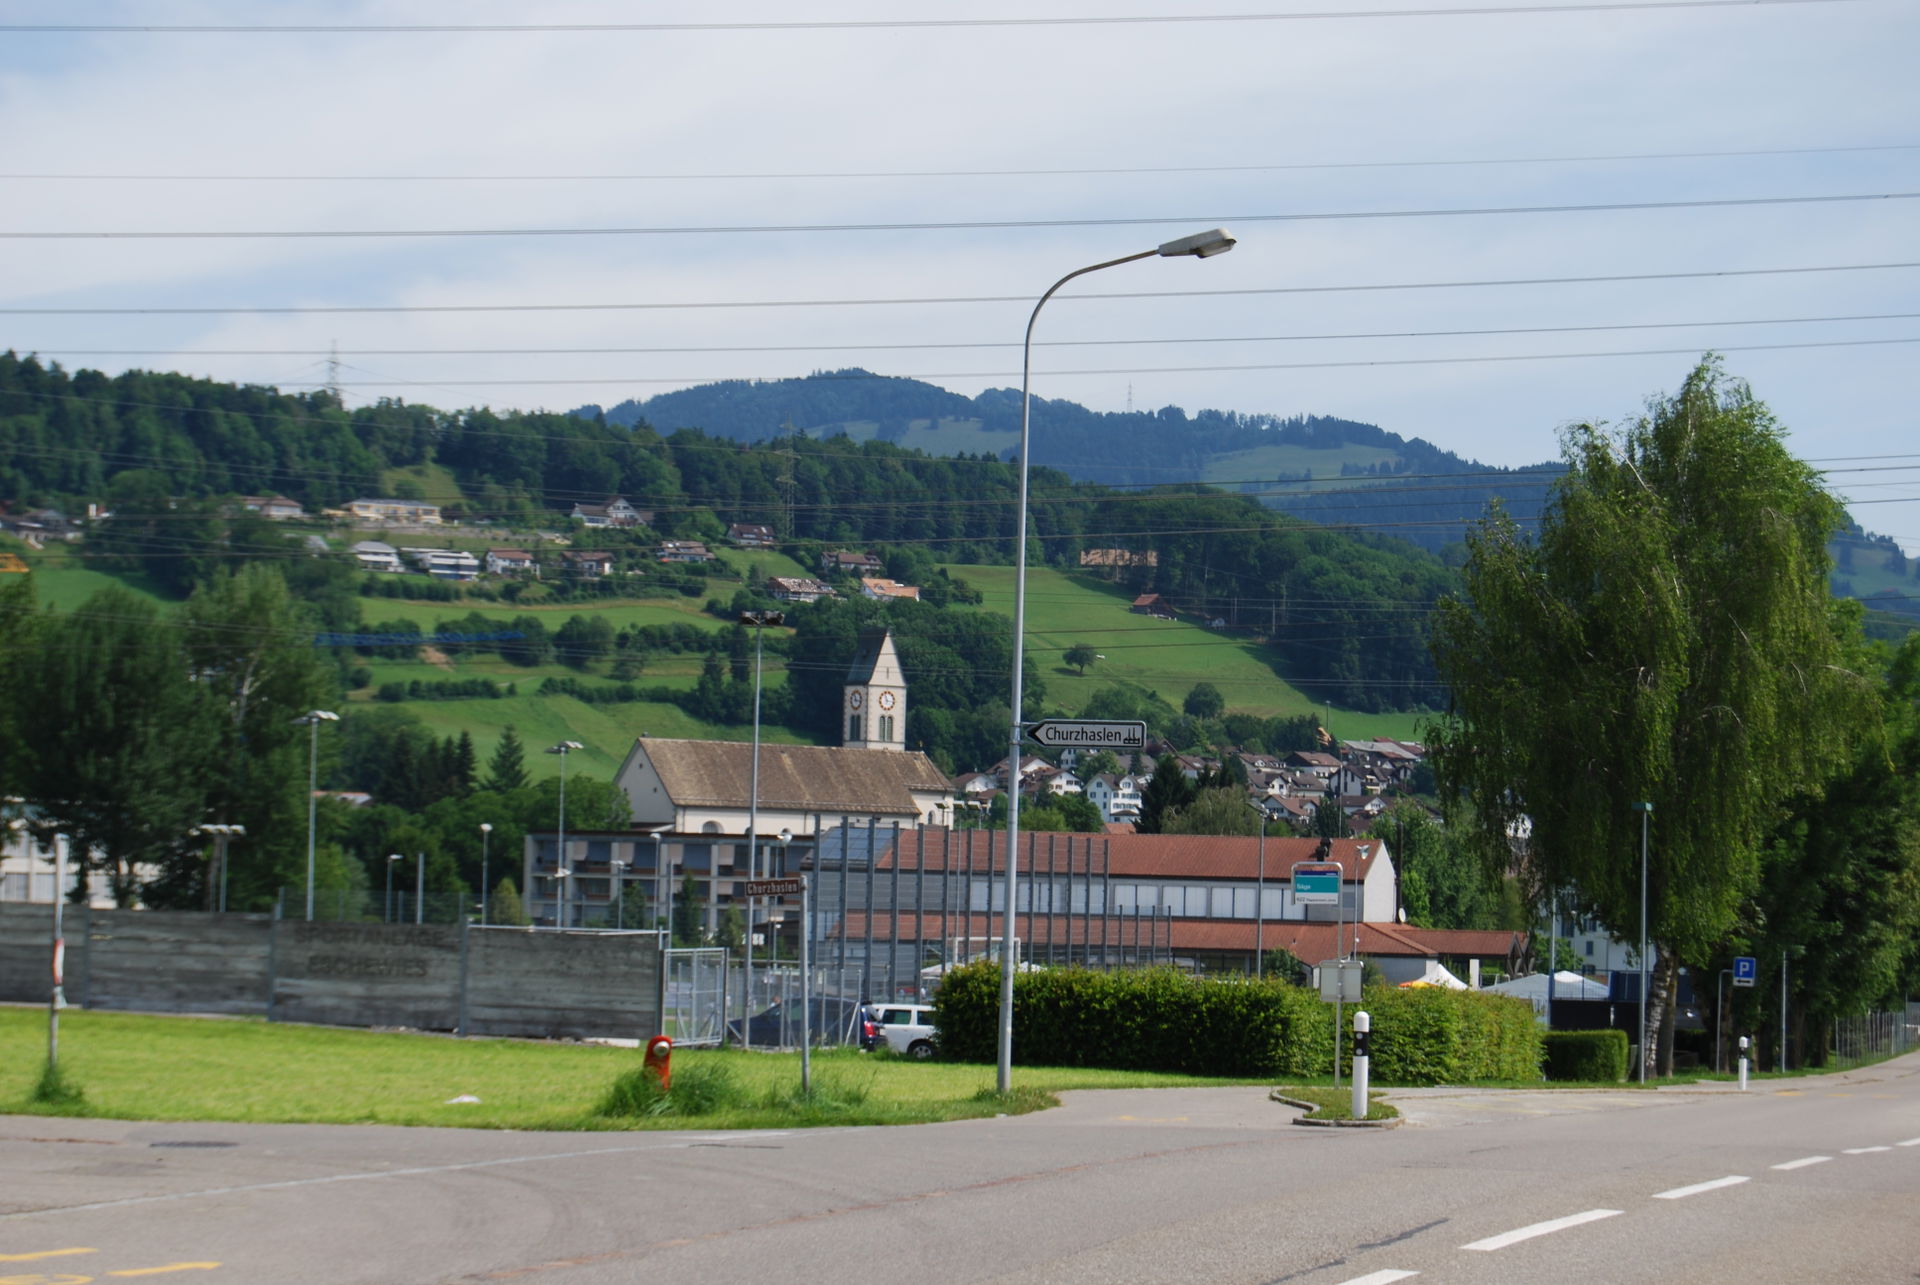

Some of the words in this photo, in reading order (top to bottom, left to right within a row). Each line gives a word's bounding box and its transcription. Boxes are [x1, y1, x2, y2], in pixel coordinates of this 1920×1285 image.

[1045, 727, 1121, 742] Churzhaslen
[747, 881, 798, 895] Churzhaslen
[1740, 961, 1749, 976] P
